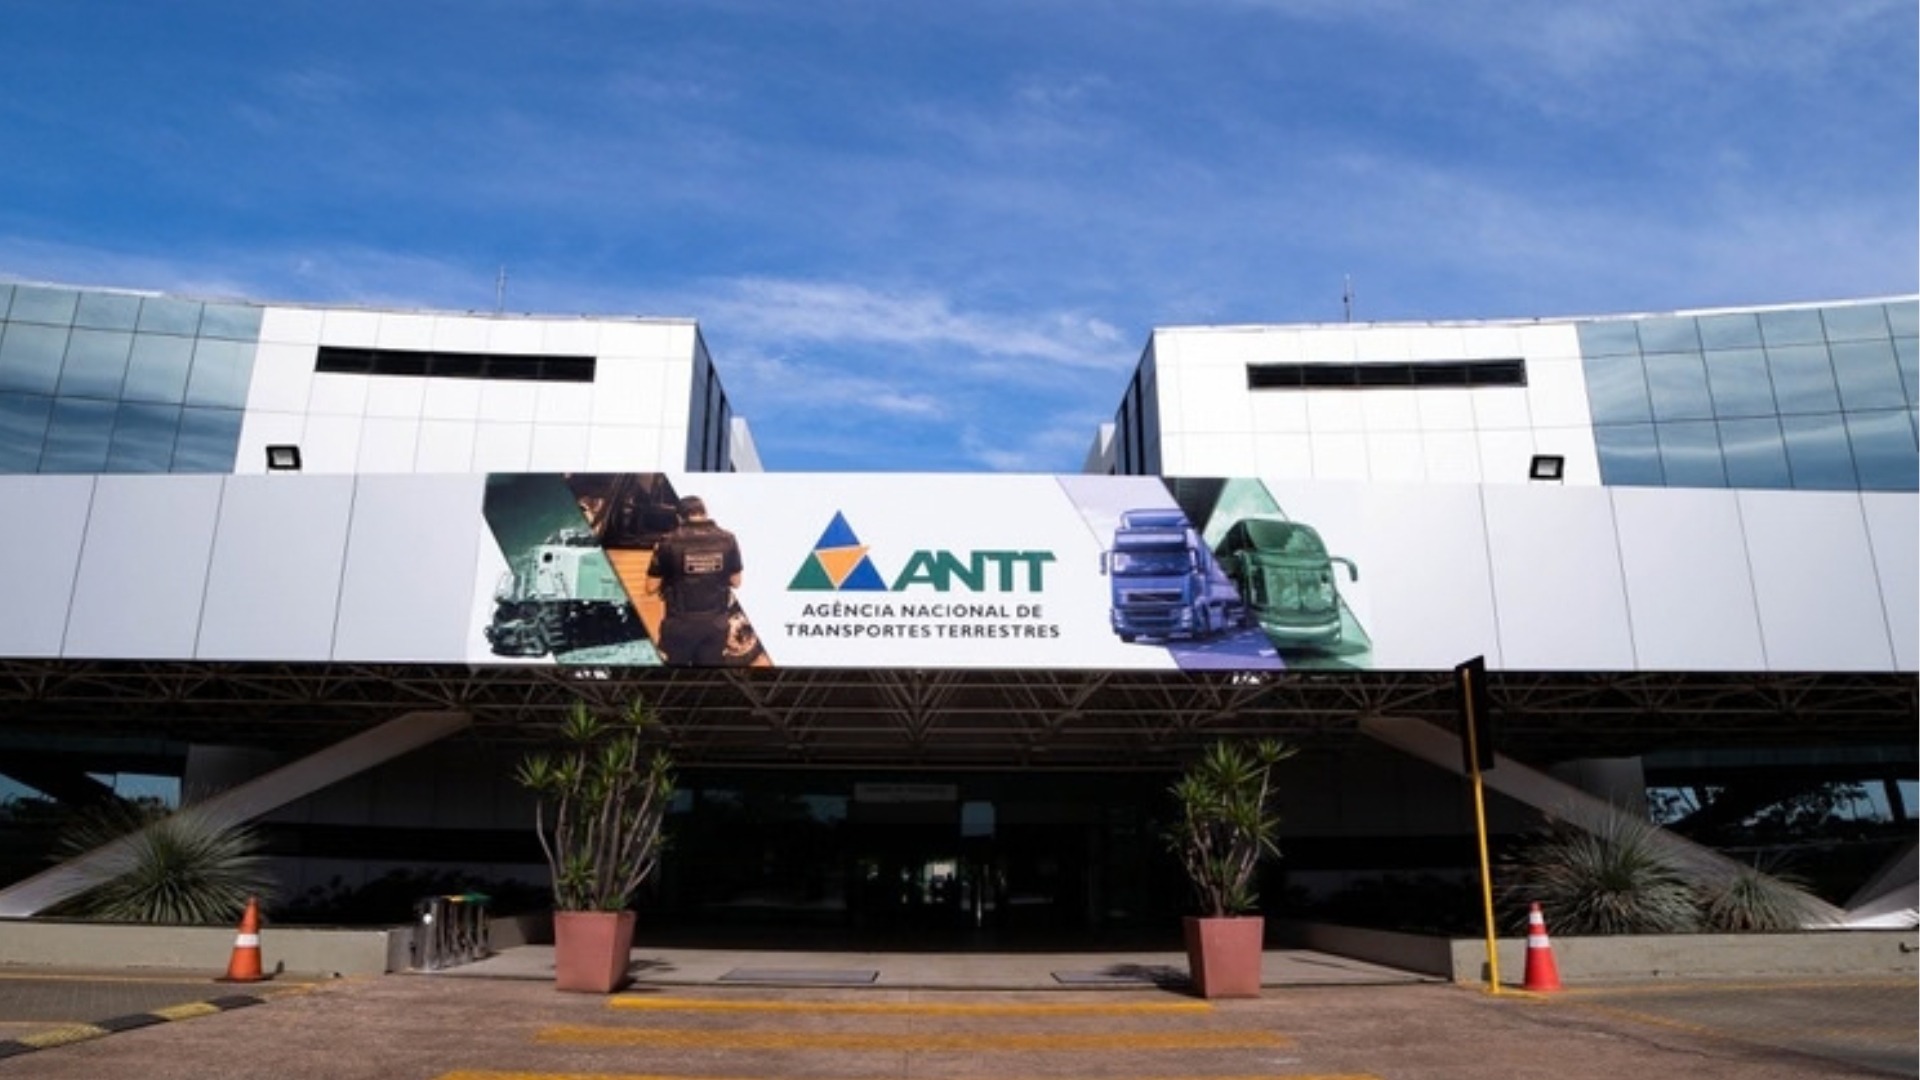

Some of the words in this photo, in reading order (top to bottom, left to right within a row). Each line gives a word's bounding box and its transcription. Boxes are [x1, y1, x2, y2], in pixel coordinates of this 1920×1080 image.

[889, 549, 1057, 592] ANTT
[801, 600, 895, 619] AGÊNCIA
[900, 604, 1010, 618] NACIONAL
[1016, 604, 1043, 618] DE
[785, 623, 932, 638] TRANSPORTES
[935, 623, 1060, 638] TERRESTRES
